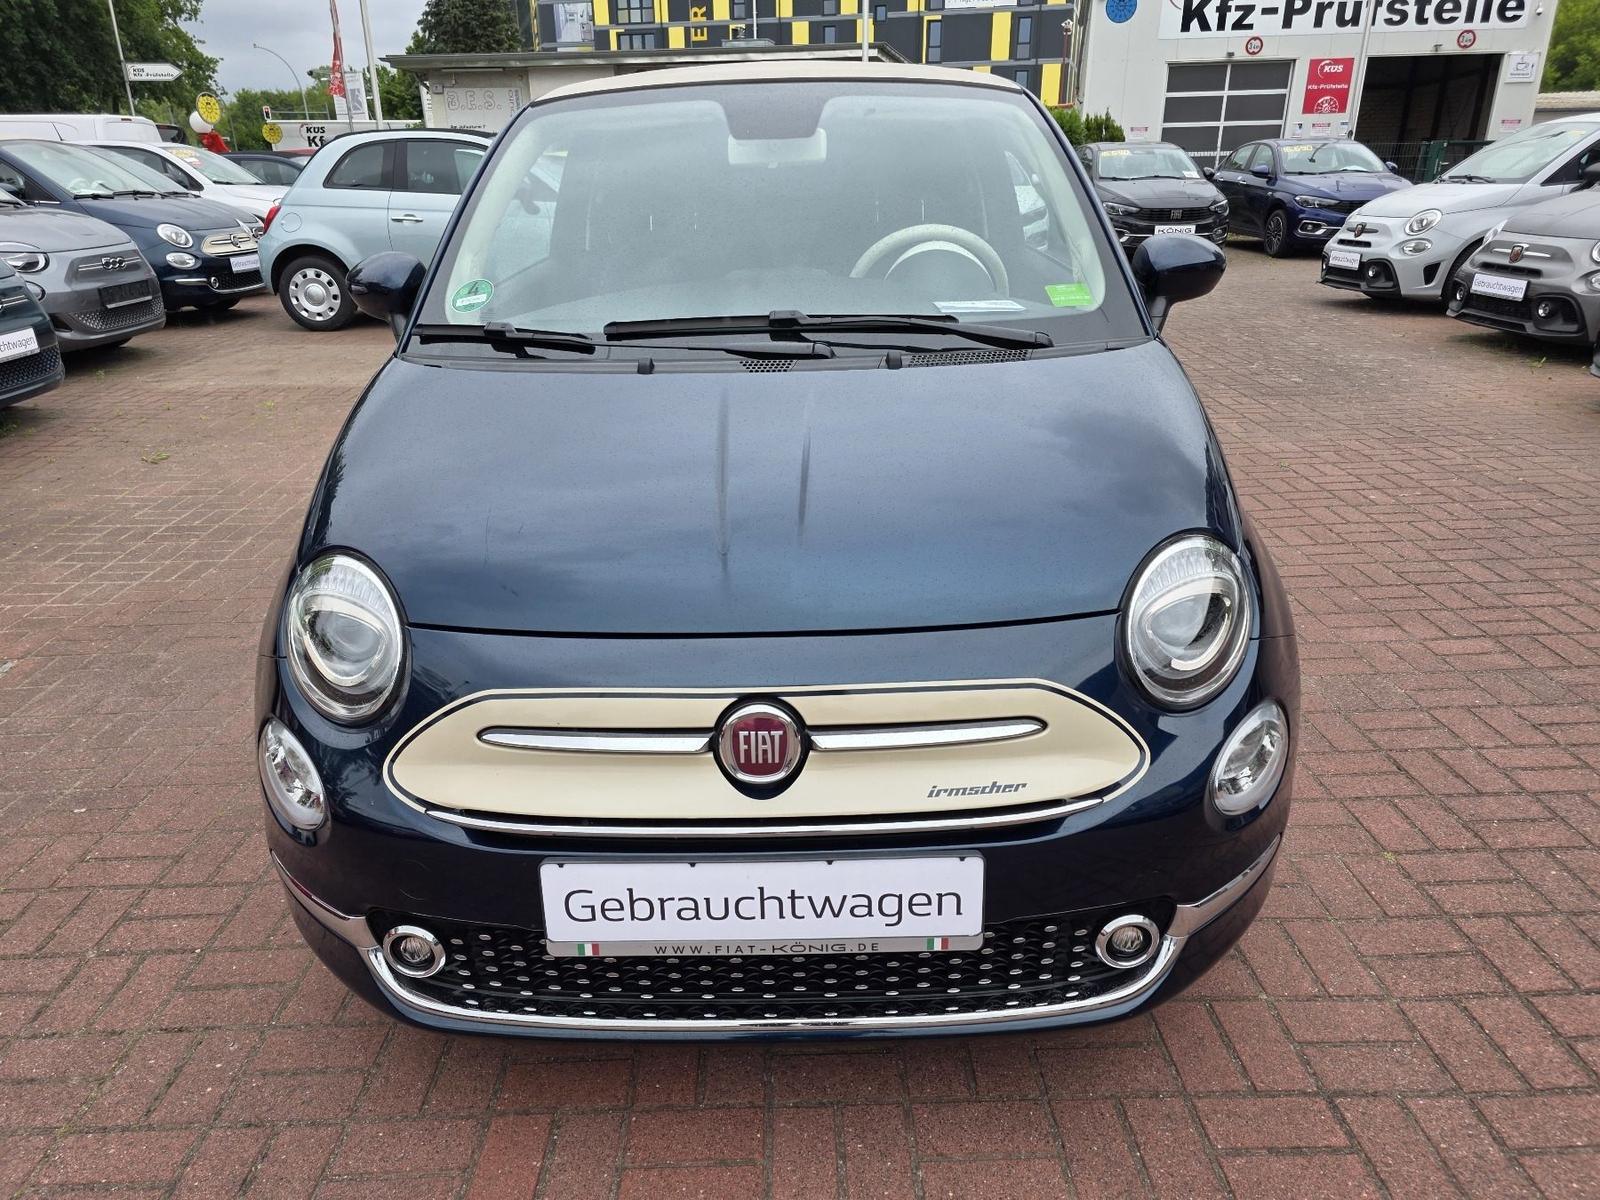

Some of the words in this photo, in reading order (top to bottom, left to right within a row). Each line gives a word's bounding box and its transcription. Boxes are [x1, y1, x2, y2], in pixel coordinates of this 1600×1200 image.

[738, 730, 783, 764] FIAT
[927, 782, 1028, 798] irmscher
[563, 886, 963, 927] Gebrauchtwagen
[654, 941, 880, 954] WWW.FIAT-KÖNIG.DE
